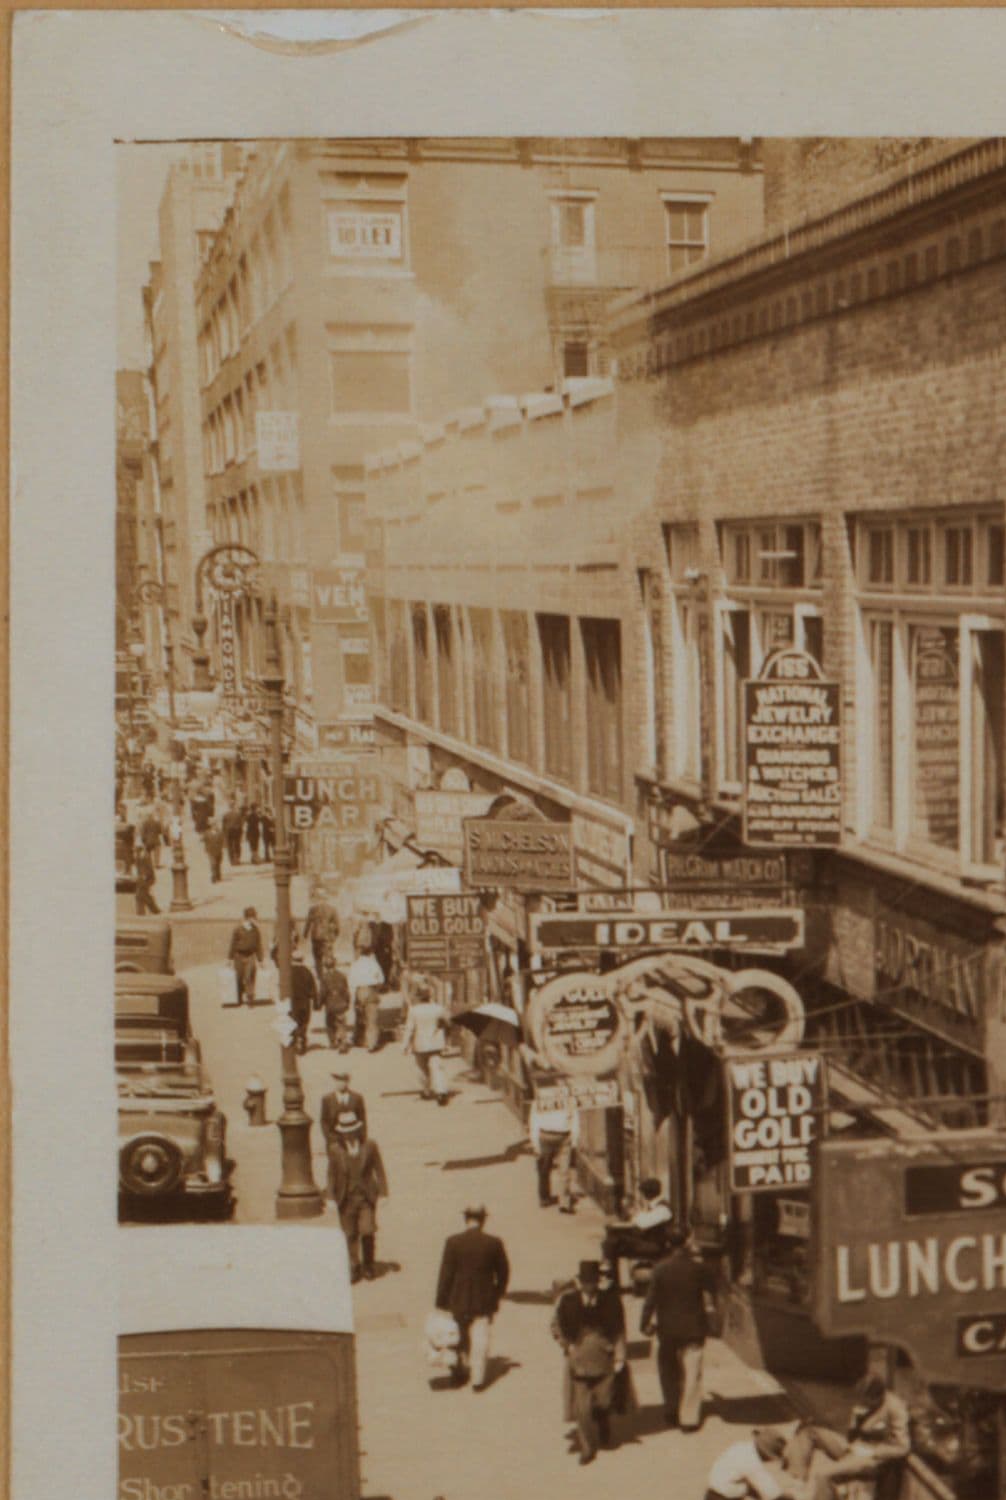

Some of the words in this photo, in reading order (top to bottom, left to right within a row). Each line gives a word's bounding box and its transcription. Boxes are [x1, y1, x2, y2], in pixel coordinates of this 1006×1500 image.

[755, 685, 828, 706] NATIONAL
[752, 705, 832, 724] JEWELRY
[748, 725, 840, 744] EXCHANGE
[283, 779, 376, 801] LUNCH
[294, 804, 363, 828] BAR
[411, 900, 437, 917] WE
[443, 900, 480, 917] BUY
[411, 917, 439, 935] OLD
[444, 916, 483, 934] GOLD
[596, 920, 748, 944] IDEAL
[731, 1062, 768, 1089] WE
[770, 1059, 818, 1087] BUY
[741, 1085, 812, 1118] OLD
[749, 1163, 811, 1185] PAID
